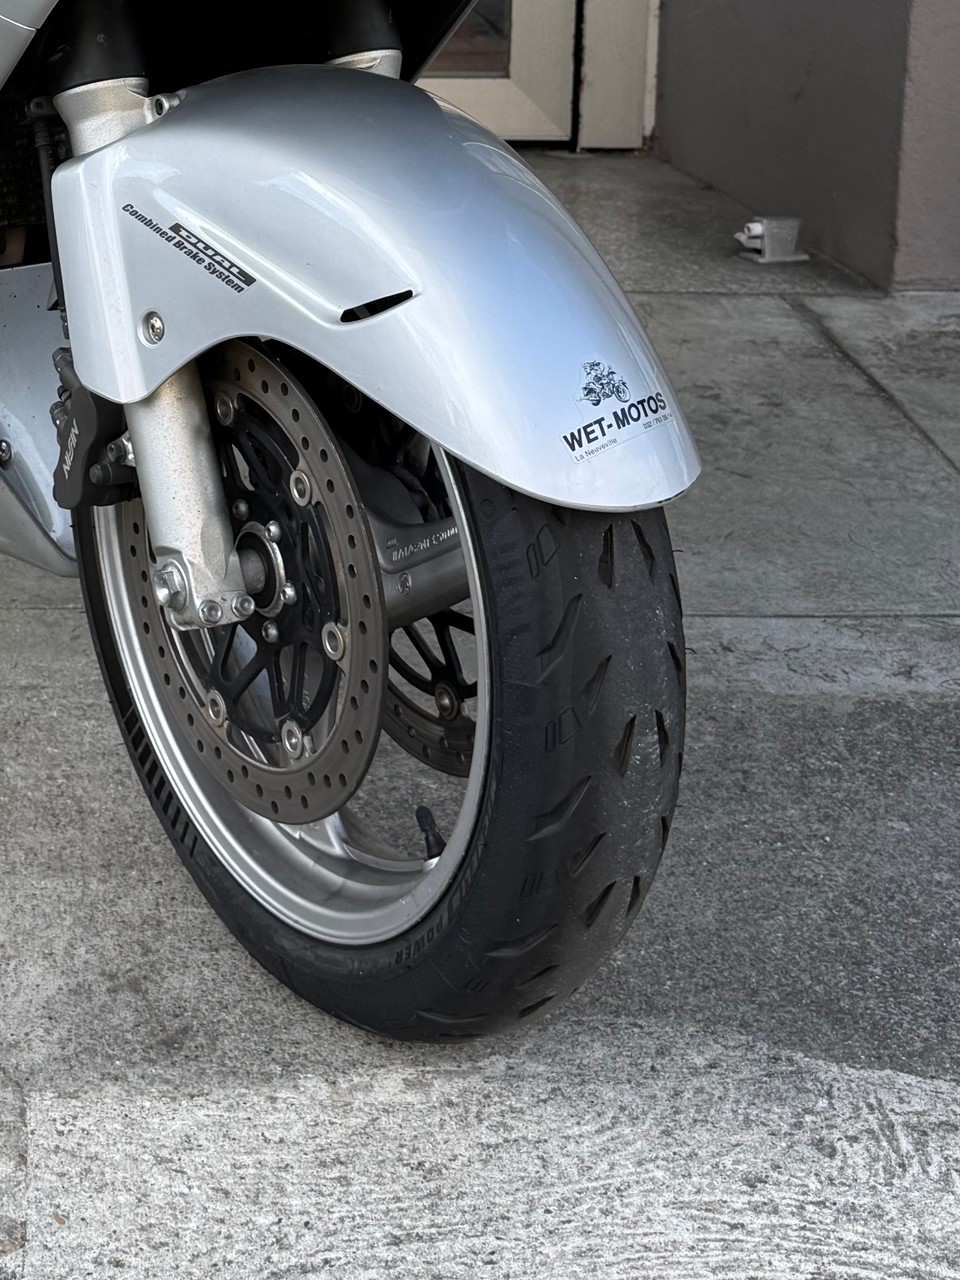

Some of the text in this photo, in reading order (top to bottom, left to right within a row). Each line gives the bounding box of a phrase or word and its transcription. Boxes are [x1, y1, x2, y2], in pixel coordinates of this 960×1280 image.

[121, 203, 246, 294] Combined Brake System
[562, 391, 667, 452] WET-MOTOS
